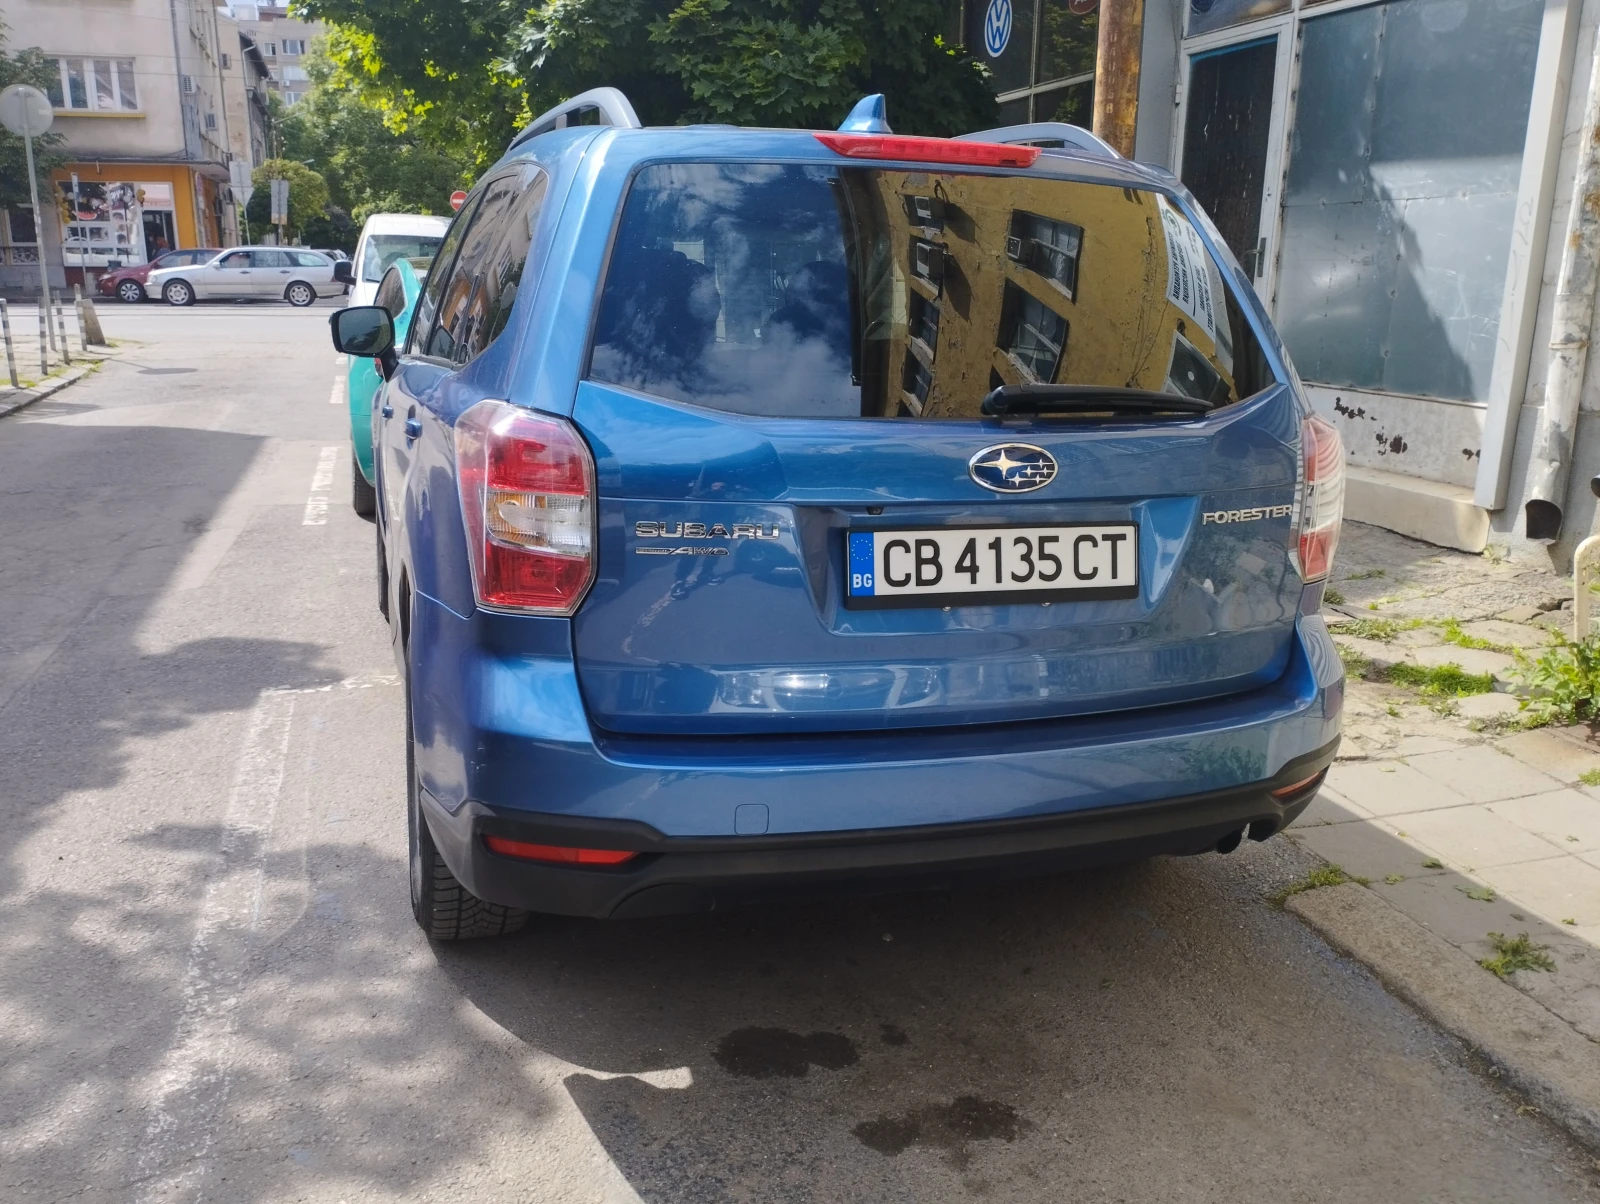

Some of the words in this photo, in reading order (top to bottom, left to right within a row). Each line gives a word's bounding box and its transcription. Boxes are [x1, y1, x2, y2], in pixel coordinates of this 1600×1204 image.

[1202, 504, 1292, 525] FORESTER
[635, 520, 780, 540] SUBARU
[672, 547, 729, 556] AWD
[883, 538, 943, 587] CB
[954, 535, 1063, 585] 4135
[1073, 533, 1127, 581] CT
[852, 573, 872, 589] BG
